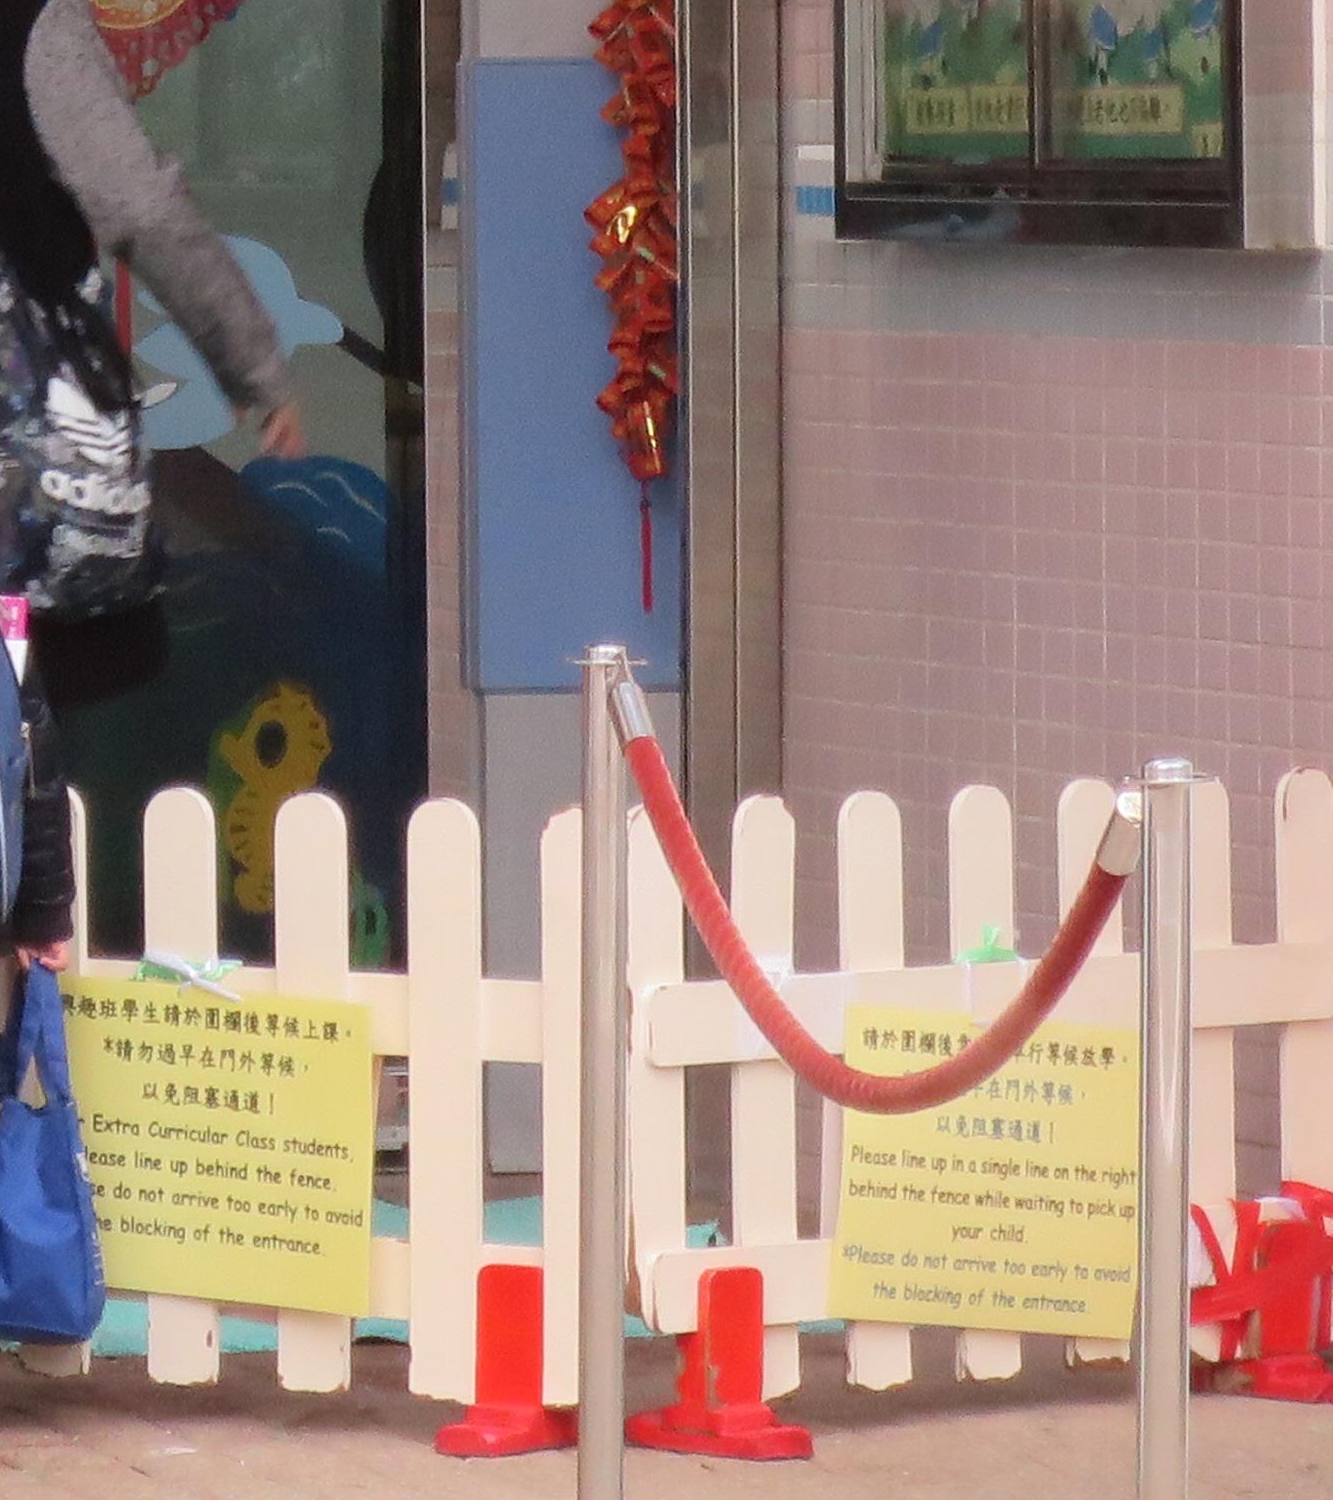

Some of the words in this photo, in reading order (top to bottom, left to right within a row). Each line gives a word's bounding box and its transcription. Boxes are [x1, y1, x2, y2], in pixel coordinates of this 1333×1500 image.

[92, 1114, 140, 1136] Extra
[148, 1121, 228, 1144] Curricular
[236, 1130, 275, 1151] Class
[84, 1145, 126, 1168] lease
[134, 1151, 162, 1170] line
[170, 1160, 188, 1178] up
[196, 1159, 248, 1181] behind
[256, 1164, 281, 1184] the
[851, 1144, 897, 1166] Please
[902, 1149, 927, 1168] line
[931, 1157, 947, 1175] up
[952, 1154, 965, 1172] in
[968, 1161, 977, 1173] a
[981, 1158, 1021, 1180] single
[1025, 1159, 1049, 1179] line
[1053, 1167, 1069, 1180] on
[1074, 1164, 1097, 1182] the
[1101, 1167, 1136, 1189] right
[113, 1182, 131, 1200] do
[138, 1188, 164, 1202] not
[171, 1190, 220, 1209] arrive
[226, 1195, 251, 1213] too
[258, 1200, 298, 1223] early
[304, 1204, 320, 1220] to
[325, 1209, 364, 1227] avoid
[849, 1178, 898, 1200] behind
[902, 1182, 926, 1201] the
[931, 1185, 970, 1206] fence
[975, 1189, 1010, 1209] while
[1014, 1195, 1065, 1218] waiting
[1069, 1198, 1084, 1214] to
[1088, 1198, 1115, 1219] pick
[1119, 1204, 1135, 1222] up
[96, 1217, 113, 1231] he
[120, 1215, 186, 1244] blocking
[193, 1224, 210, 1241] of
[219, 1228, 245, 1245] the
[951, 1223, 983, 1243] your
[901, 1248, 919, 1268] do
[923, 1254, 947, 1270] not
[953, 1256, 997, 1274] arrive
[1004, 1259, 1026, 1275] too
[1031, 1261, 1068, 1282] early
[1074, 1264, 1089, 1280] to
[873, 1281, 896, 1299] the
[904, 1283, 962, 1309] blocking
[968, 1287, 985, 1305] of
[992, 1290, 1016, 1308] the
